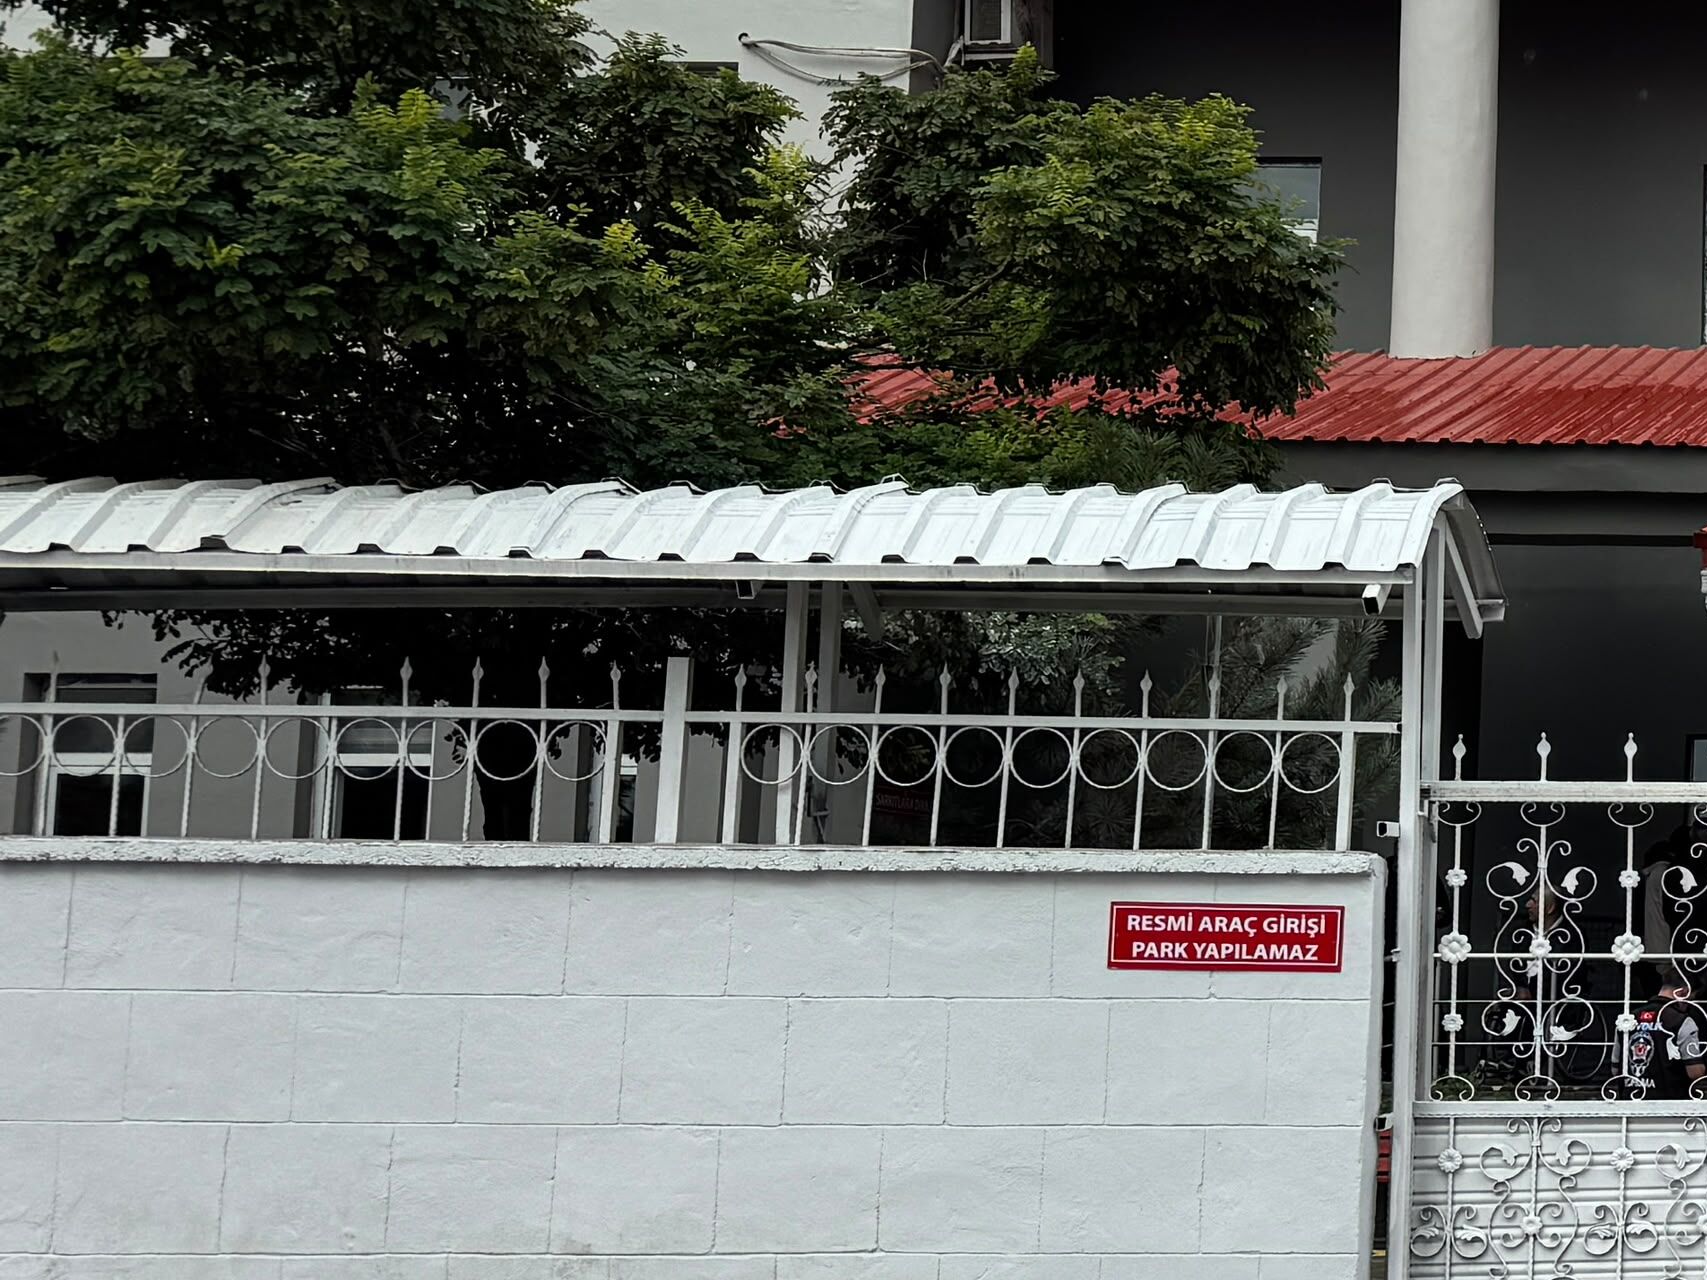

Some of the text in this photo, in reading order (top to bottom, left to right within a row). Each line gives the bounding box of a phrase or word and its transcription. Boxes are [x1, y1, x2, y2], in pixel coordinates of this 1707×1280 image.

[1127, 912, 1326, 938] RESMİ ARAÇ GİRİŞİ
[1132, 941, 1319, 961] PARK YAPILAMAZ
